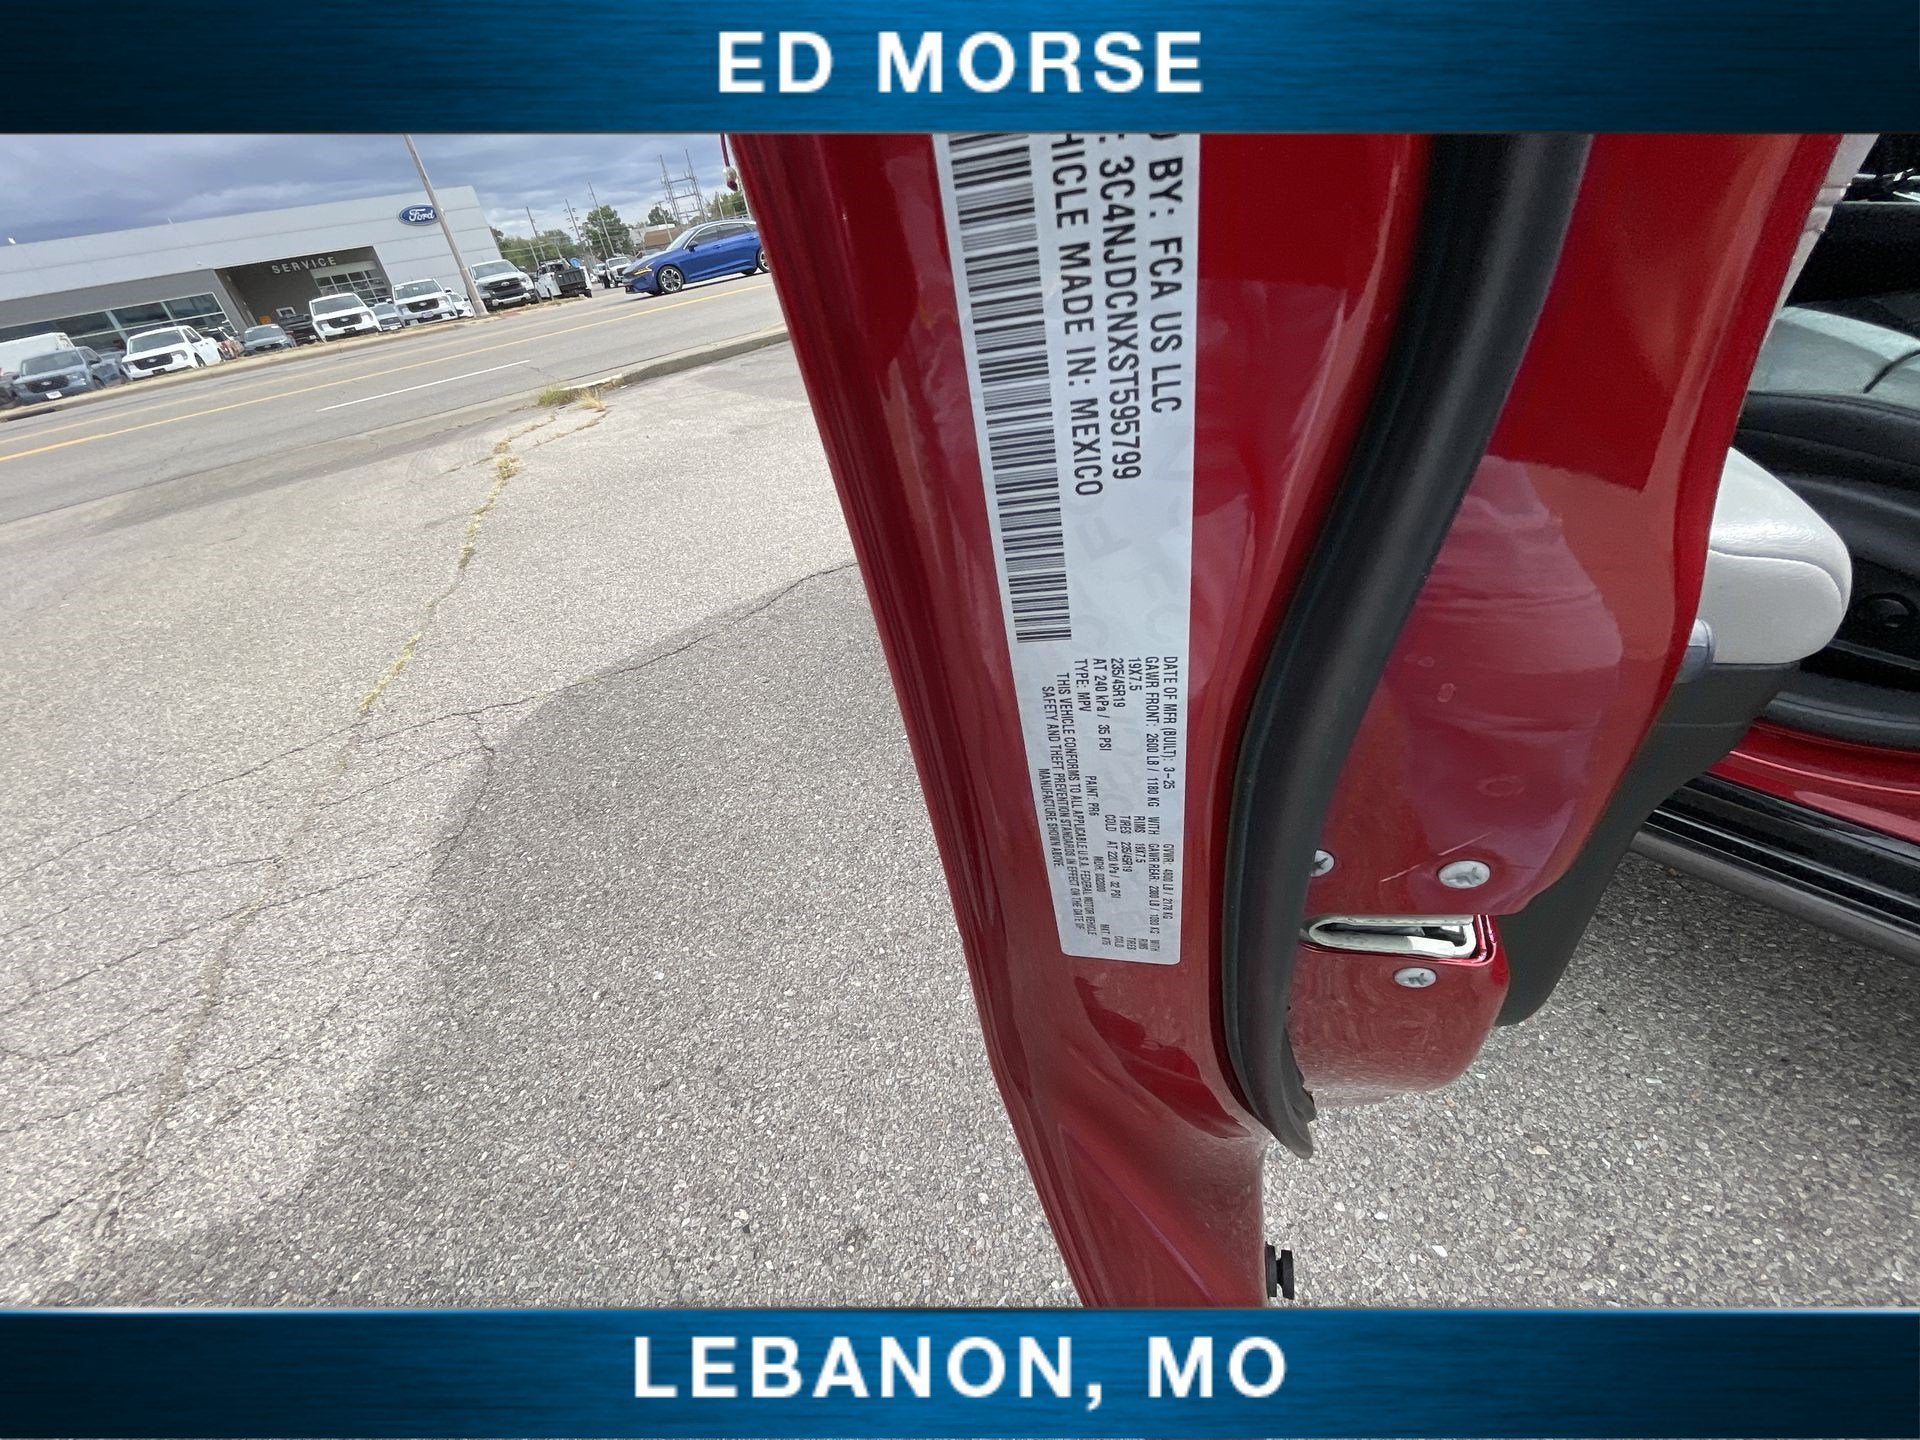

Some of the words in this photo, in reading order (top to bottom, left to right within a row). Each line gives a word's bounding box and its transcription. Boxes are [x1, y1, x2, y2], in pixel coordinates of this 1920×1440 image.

[1150, 157, 1183, 218] BY:
[408, 208, 435, 222] Ford
[271, 256, 337, 274] SERVICE
[1150, 236, 1183, 300] FCA
[1058, 242, 1095, 335] MADE
[1100, 156, 1142, 479] 3C4NJDCNXST595799
[1150, 311, 1182, 353] US
[1066, 345, 1097, 387] IN:
[1151, 363, 1182, 413] LLC
[1069, 397, 1103, 495] MEXICO
[1074, 659, 1089, 688] TYPE:
[1093, 658, 1107, 671] AT
[1129, 657, 1142, 691] 19X7.5
[1145, 656, 1160, 688] GAWR
[1164, 656, 1178, 683] DATE
[1056, 673, 1070, 694] THIS
[1094, 675, 1108, 692] 240
[1164, 688, 1178, 699] OF
[1042, 686, 1058, 720] SAFETY
[1077, 692, 1092, 712] MPV
[1096, 695, 1109, 711] kPa
[1146, 692, 1160, 726] FRONT:
[1059, 698, 1075, 734] VEHICLE
[1164, 704, 1178, 724] MFR
[1046, 724, 1060, 742] AND
[1098, 724, 1111, 734] 35
[1099, 737, 1112, 751] PSI
[1111, 658, 1126, 708] 235/45R19
[1120, 816, 1131, 834] TIRES
[1146, 734, 1159, 752] 2600
[1160, 728, 1177, 761] (BUILT):
[1050, 744, 1064, 770] THEFT
[1064, 737, 1080, 781] CONFORMS
[1147, 756, 1159, 765] LB
[1069, 784, 1081, 793] TO
[1085, 776, 1099, 800] PAINT:
[1147, 777, 1159, 795] 1180
[1163, 767, 1176, 790] 3-25
[1038, 768, 1059, 821] MANUFACTURE
[1053, 773, 1070, 817] PREVENTION
[1071, 795, 1082, 808] ALL
[1148, 797, 1159, 807] KG
[1088, 803, 1100, 816] PR6
[1072, 810, 1088, 848] APPLICABLE
[1104, 814, 1117, 832] COLD
[1134, 816, 1146, 833] RIMS
[1148, 816, 1160, 834] WITH
[1047, 823, 1061, 846] SHOWN
[1060, 819, 1075, 856] STANDARDS
[1106, 841, 1118, 850] AT
[1108, 850, 1119, 860] 220
[1134, 843, 1146, 863] 19X7.5
[1148, 843, 1160, 862] GAWR
[1162, 844, 1174, 864] GVWR:
[1120, 842, 1132, 872] 235/45R19
[1066, 866, 1079, 886] EFFECT
[1109, 863, 1120, 874] kPa
[1149, 864, 1160, 882] REAR:
[1070, 888, 1081, 896] ON
[1080, 870, 1092, 895] FEDERAL
[1072, 897, 1083, 908] THE
[1110, 890, 1121, 899] PSI
[1073, 908, 1084, 922] DATE
[1083, 896, 1095, 914] MOTOR
[1085, 916, 1097, 936] VEHICLE
[1150, 926, 1160, 934] KG
[1150, 939, 1160, 952] WITH
